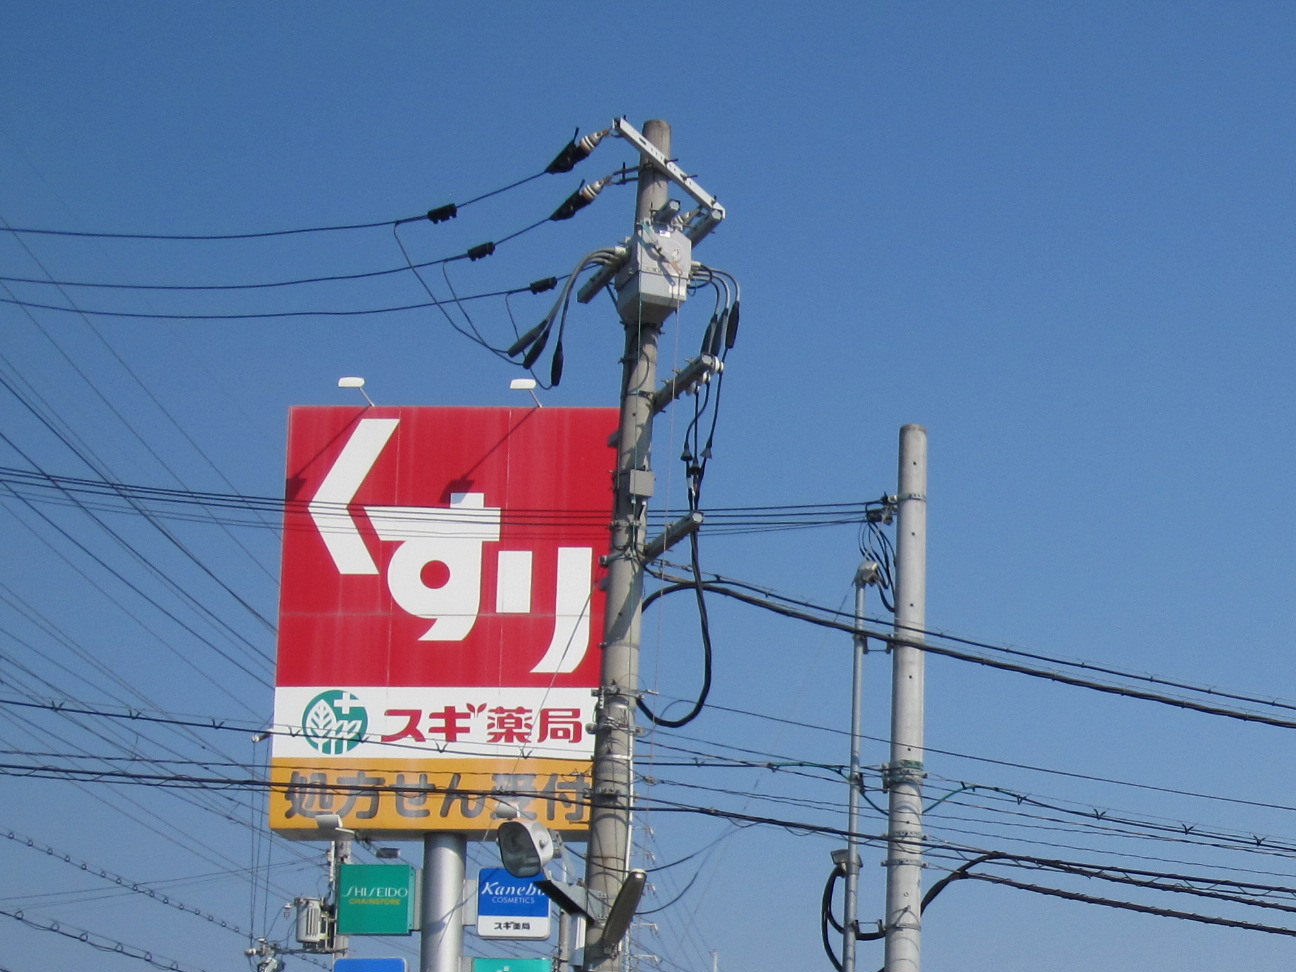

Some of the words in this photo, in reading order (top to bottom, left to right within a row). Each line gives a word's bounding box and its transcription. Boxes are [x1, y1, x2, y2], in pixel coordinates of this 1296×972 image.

[307, 418, 593, 674] くすり
[380, 703, 583, 744] スギ薬局
[284, 770, 590, 821] 処方せん受付
[342, 885, 408, 898] SHISEIDO
[491, 896, 535, 905] COSMETICS
